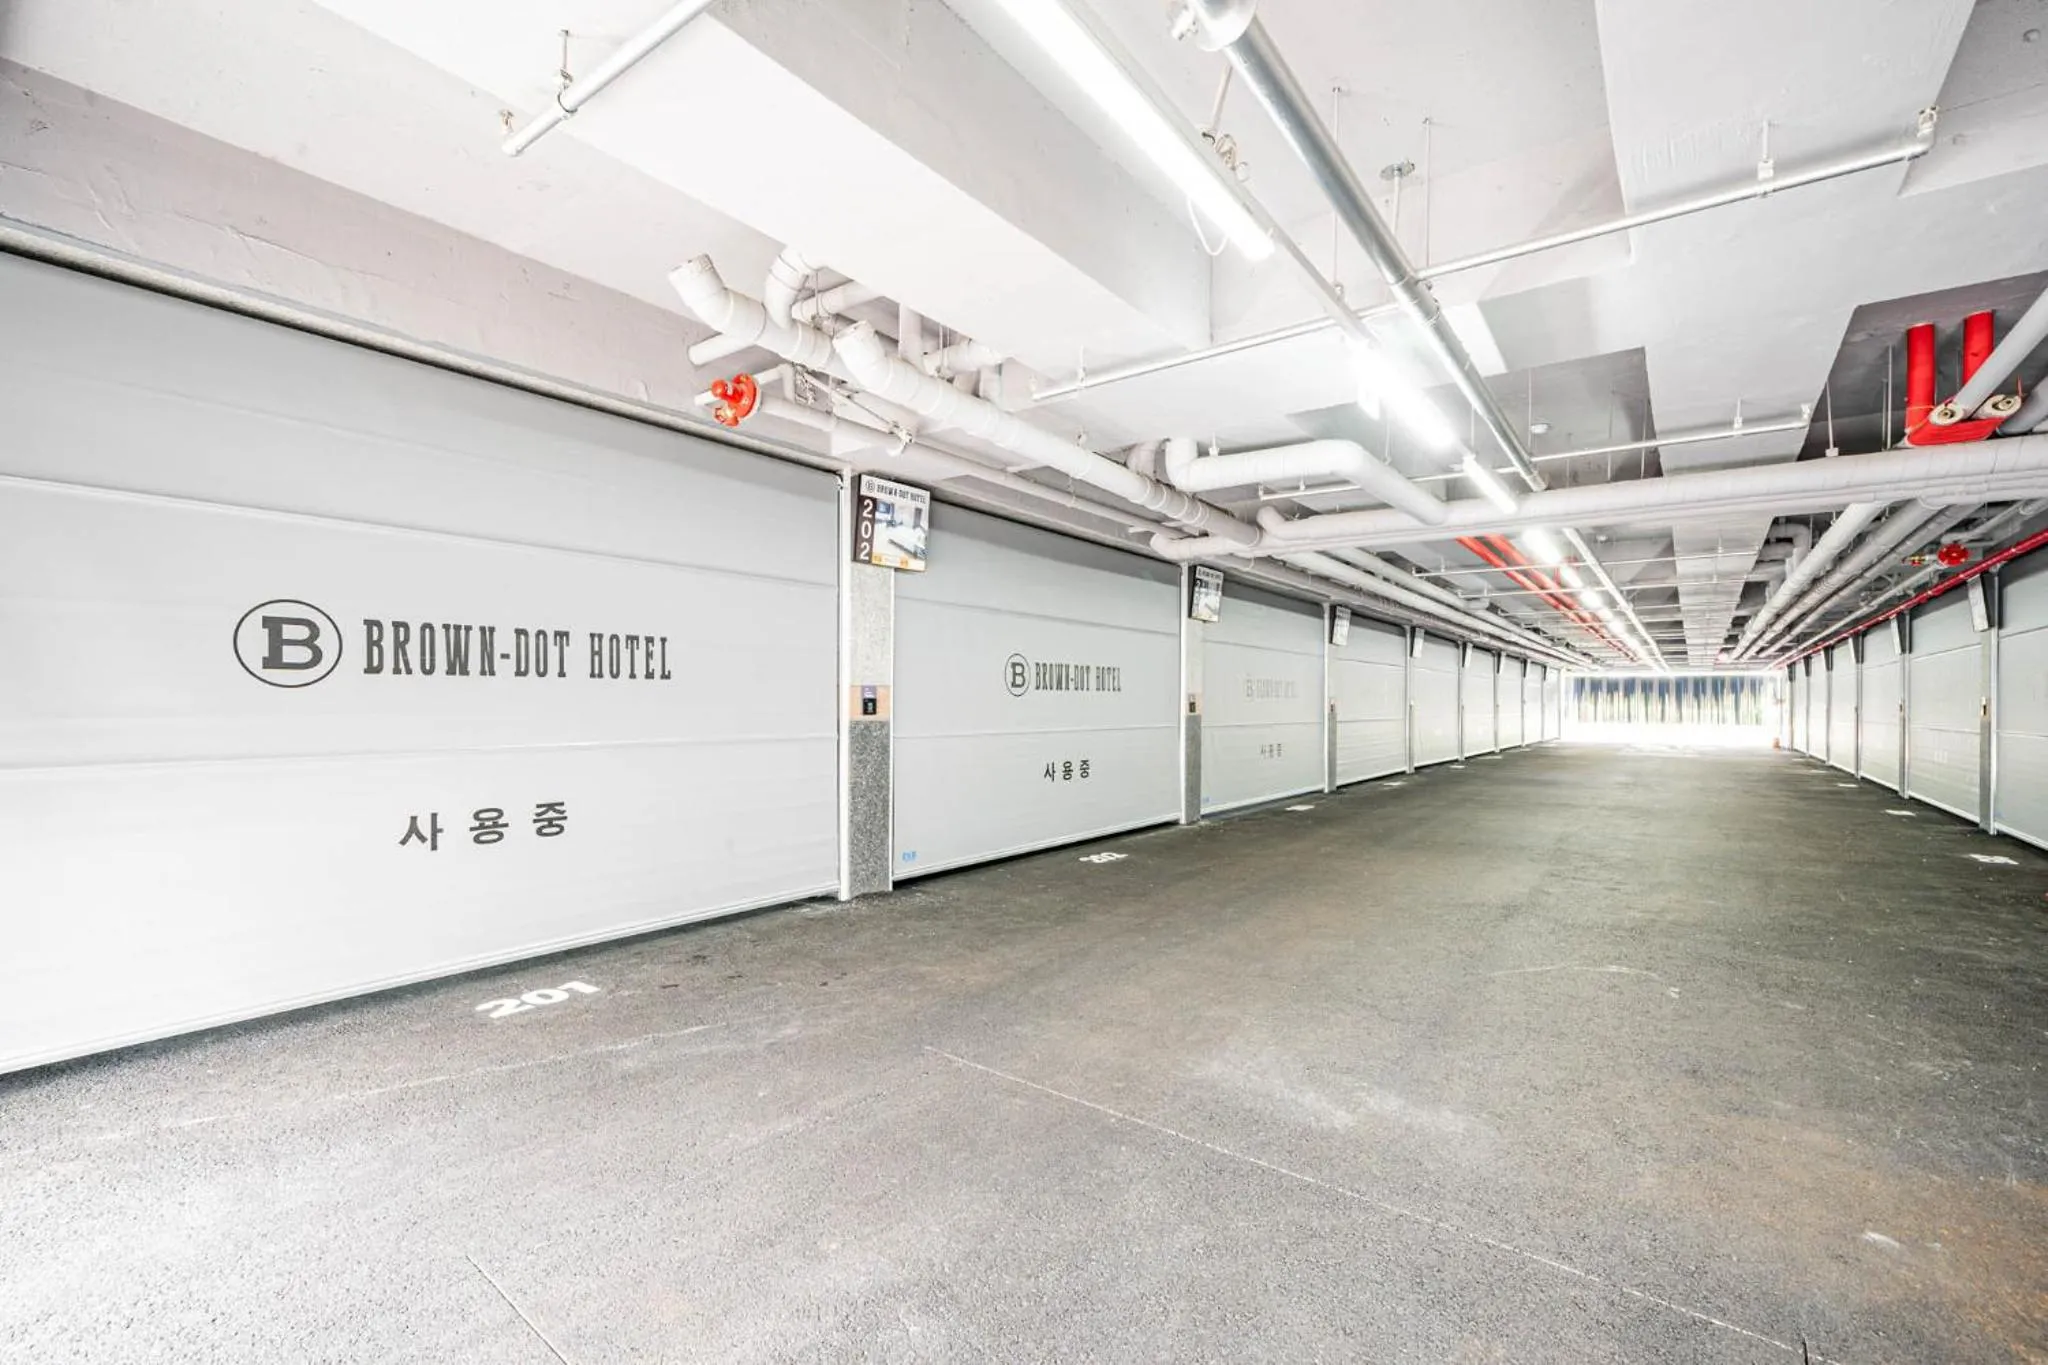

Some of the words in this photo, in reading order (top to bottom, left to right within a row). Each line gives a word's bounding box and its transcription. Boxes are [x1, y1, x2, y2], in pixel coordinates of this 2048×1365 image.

[860, 498, 873, 561] 202
[262, 615, 323, 670] B
[363, 619, 570, 678] BROWN-DOT
[589, 632, 671, 680] HOTEL
[1035, 662, 1091, 691] BROWN-DOT
[1096, 666, 1121, 692] HOTEL
[475, 980, 601, 1019] 201
